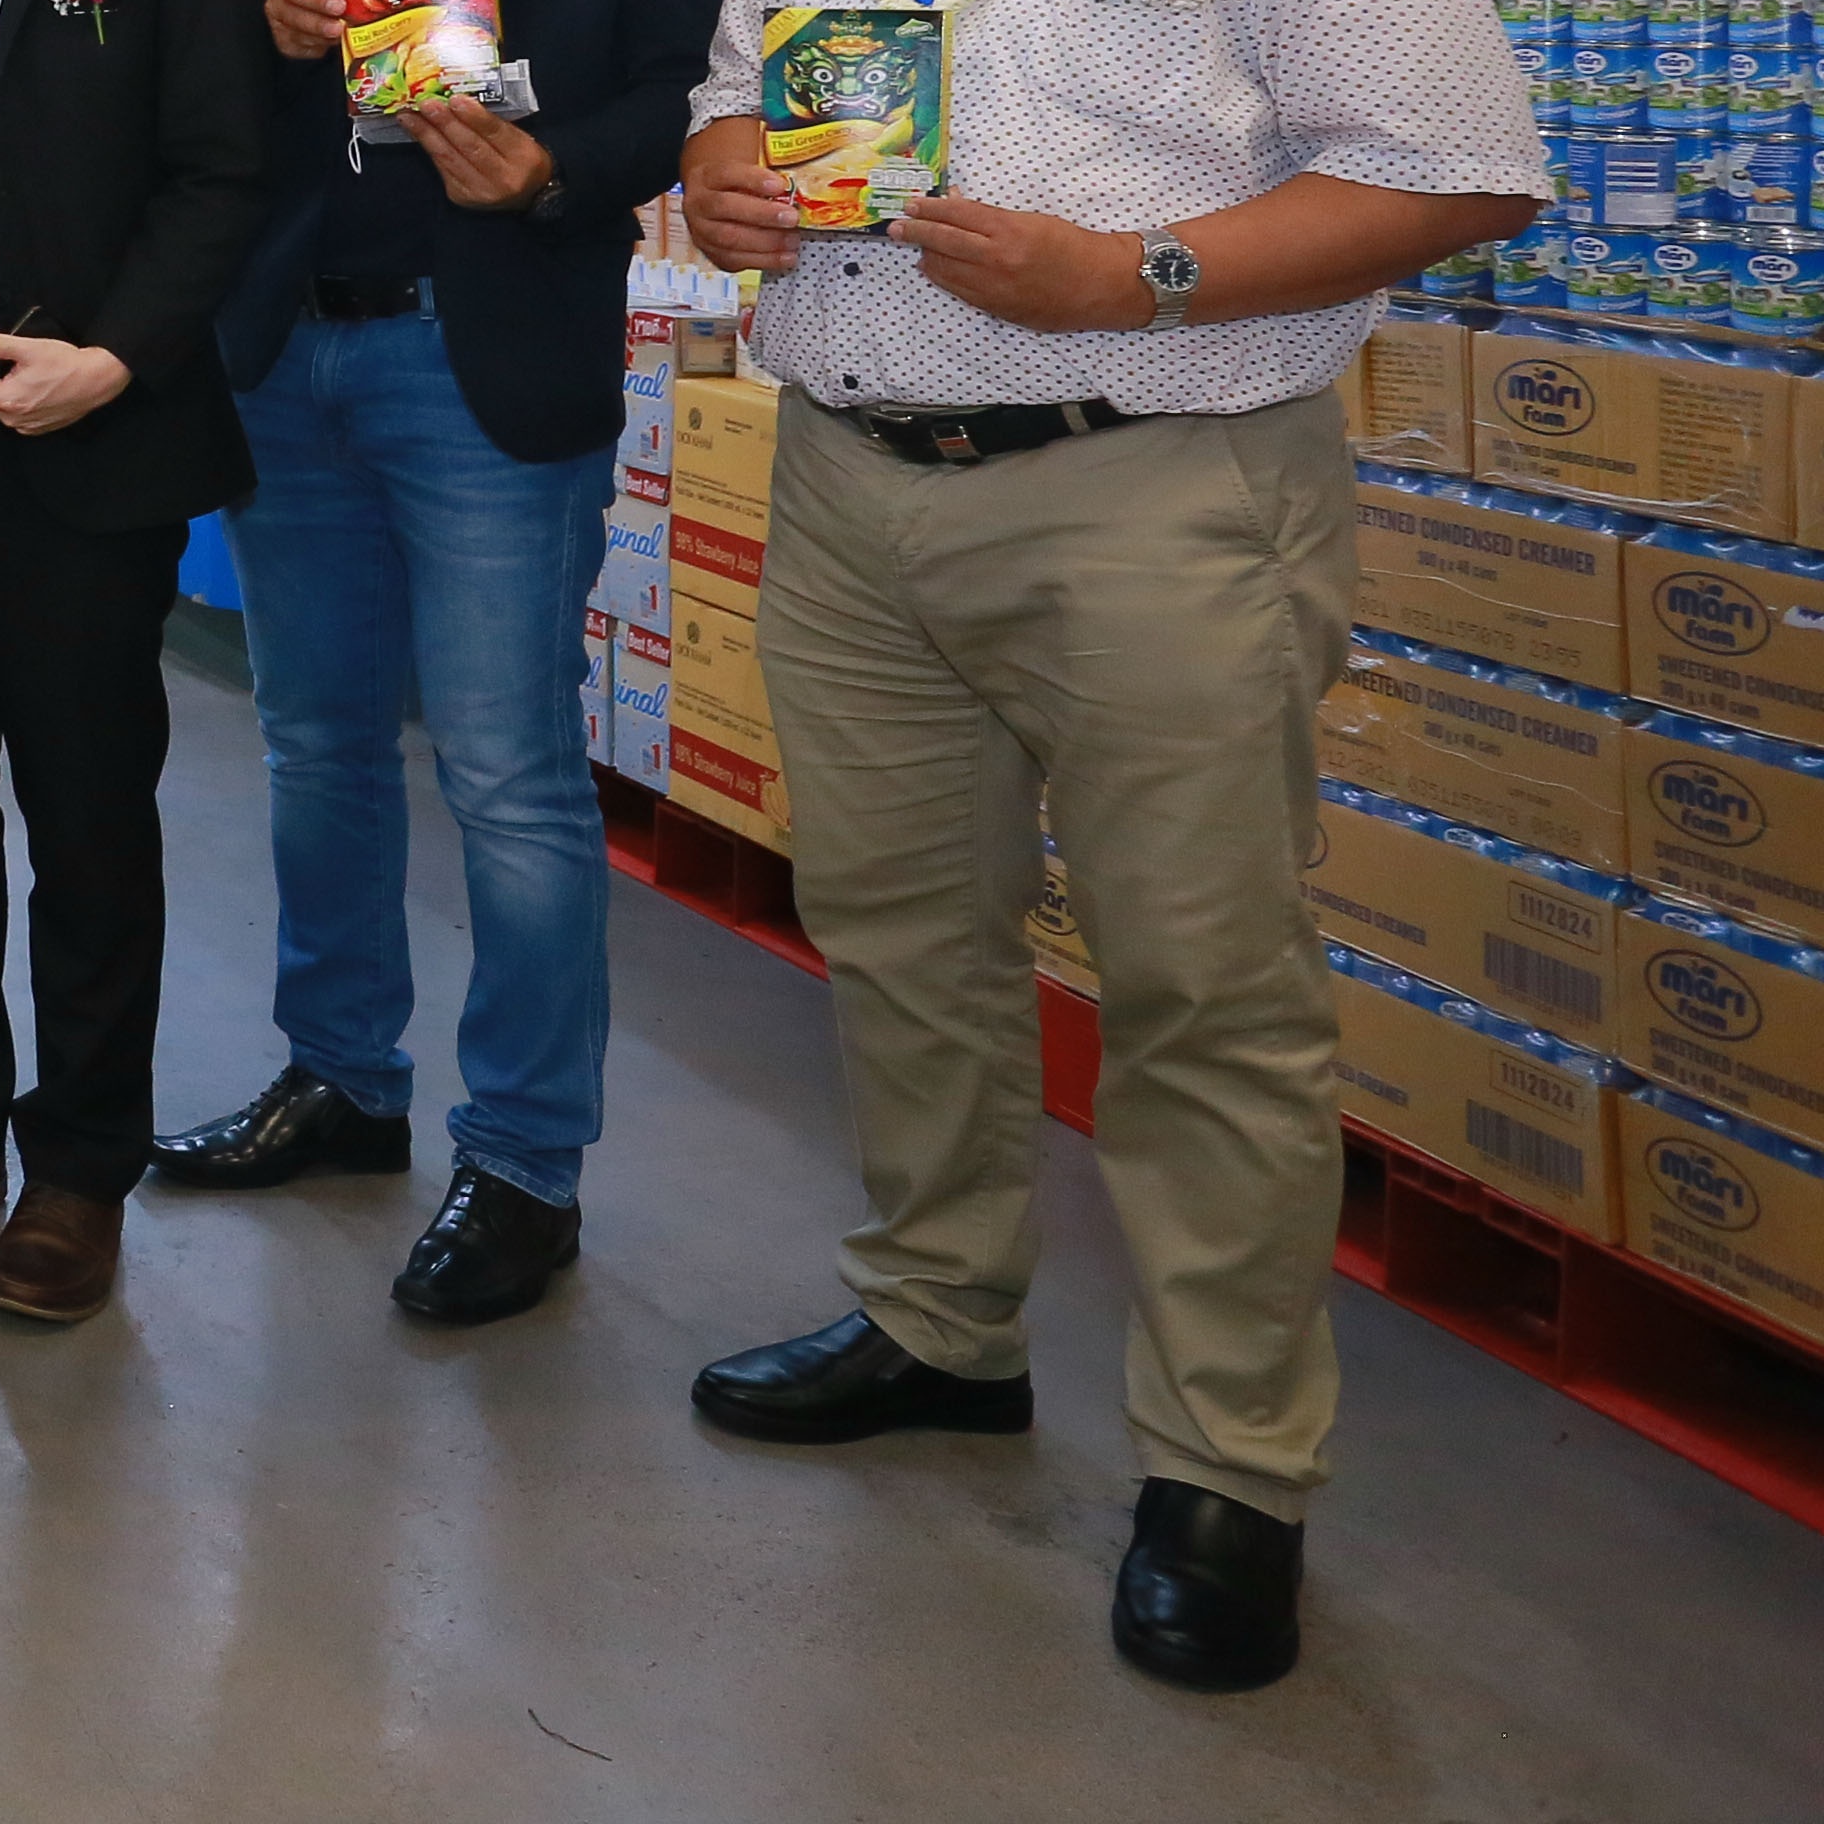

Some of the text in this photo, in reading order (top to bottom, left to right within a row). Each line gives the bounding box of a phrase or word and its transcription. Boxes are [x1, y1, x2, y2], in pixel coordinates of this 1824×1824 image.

[351, 30, 373, 45] Thai
[771, 137, 795, 151] Thai
[694, 533, 738, 573] Strawberry
[738, 549, 761, 574] Juice
[1420, 515, 1513, 558] CONDENSED
[1518, 535, 1597, 577] CREAMER
[1426, 687, 1517, 736] CONDENSED
[1521, 715, 1600, 758] CREAMER
[693, 750, 736, 791] Strawberry
[735, 773, 758, 796] Juice
[1518, 891, 1595, 939] 1112824
[1501, 1059, 1577, 1112] 1112824
